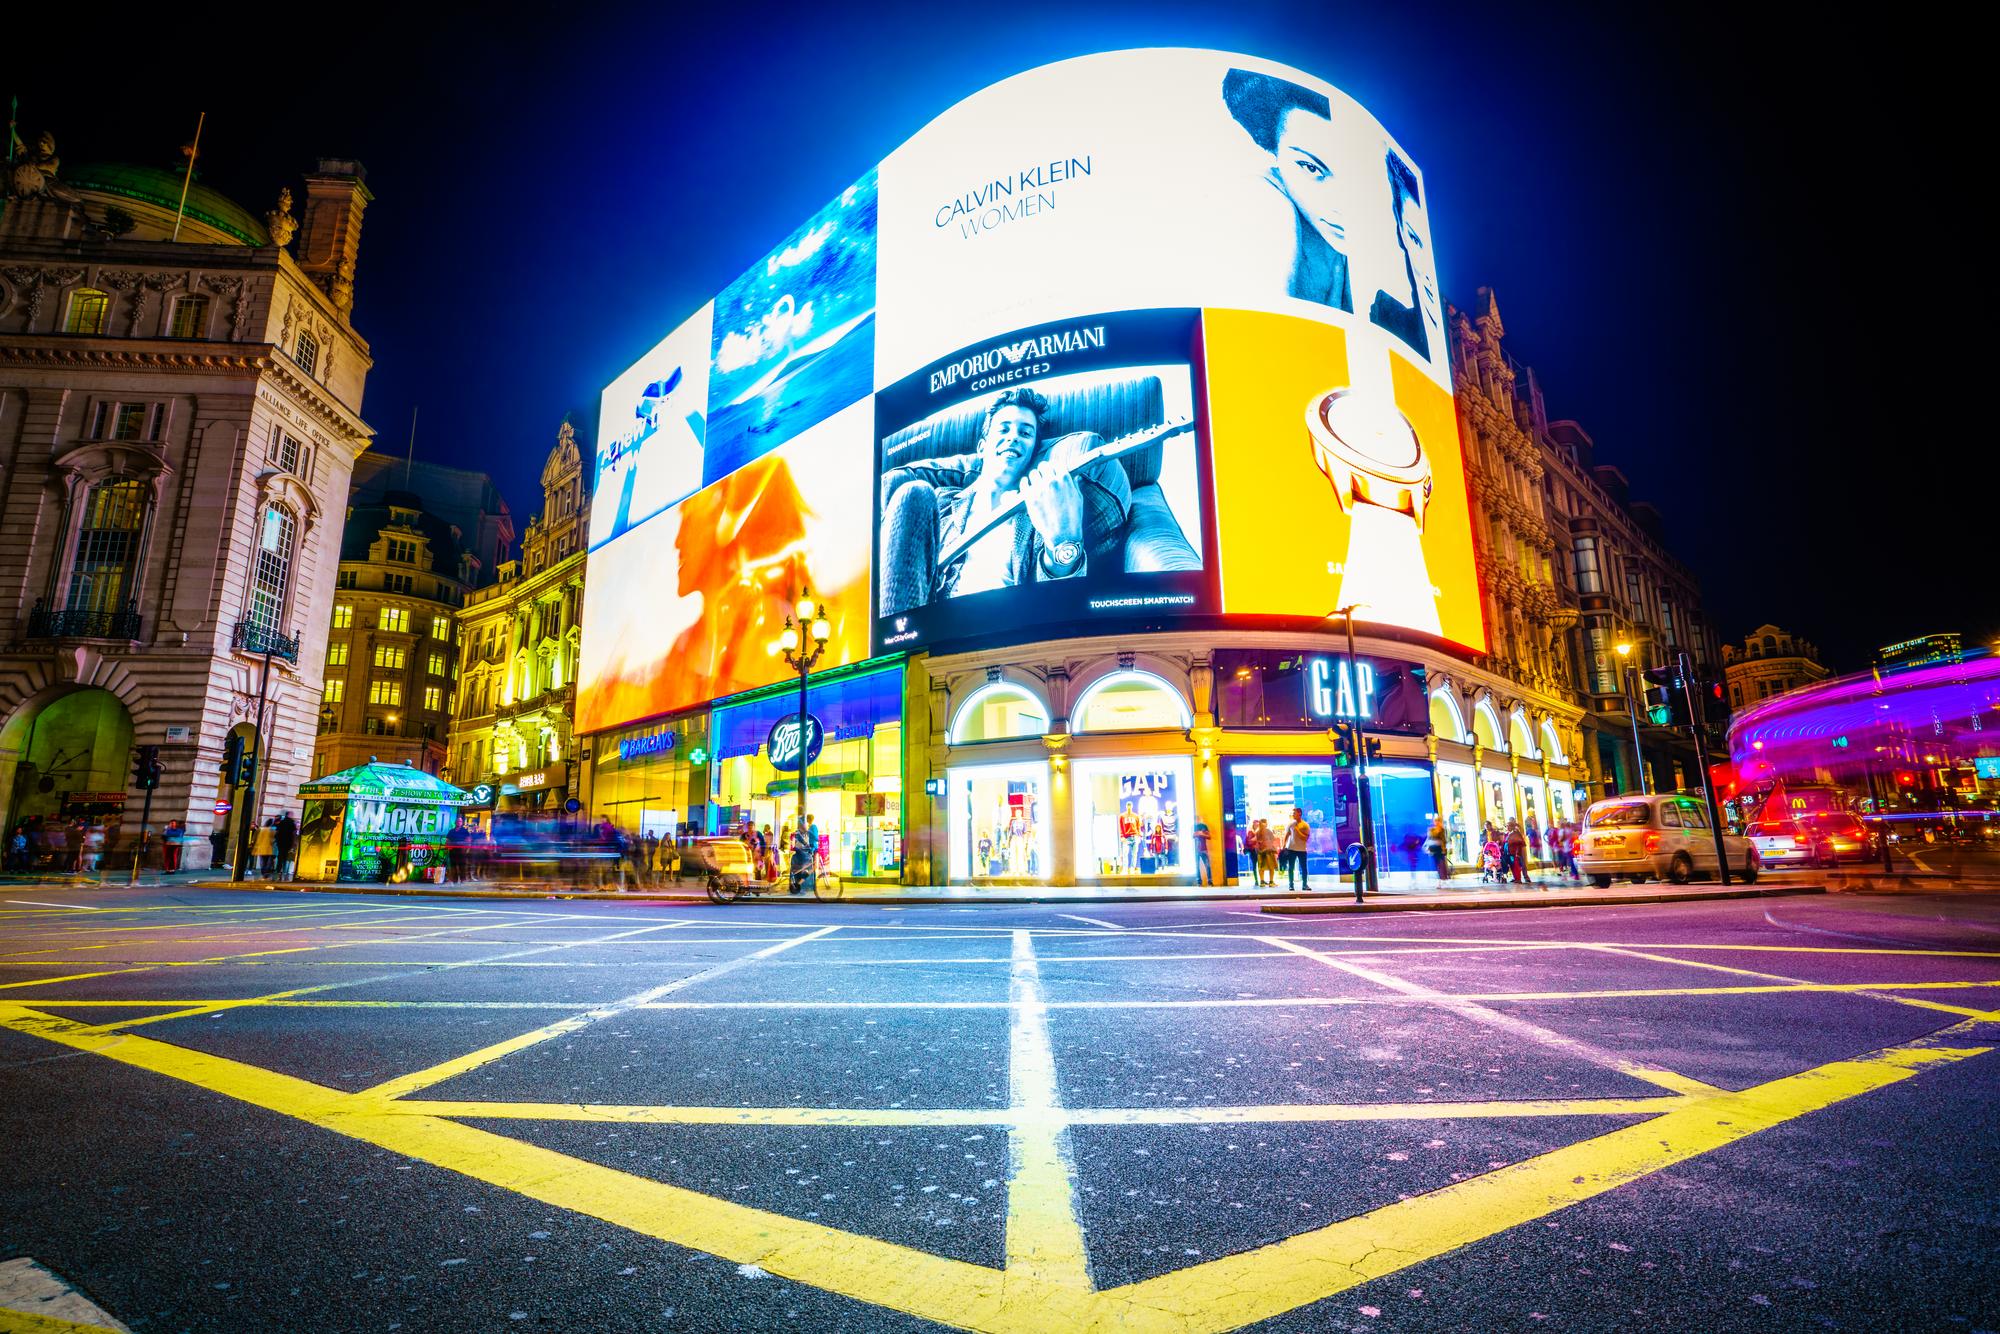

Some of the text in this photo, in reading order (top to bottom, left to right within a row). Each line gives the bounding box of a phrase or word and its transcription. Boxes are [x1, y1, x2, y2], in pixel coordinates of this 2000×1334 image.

[936, 155, 1091, 228] CALVIN KLEIN
[961, 190, 1055, 239] WOMEN
[930, 326, 1106, 394] EMPORIO ARMANI
[971, 363, 1050, 391] CONNECTED
[261, 390, 330, 448] ALLIANCE LIFE OFFICE
[1090, 596, 1194, 608] TOUCHSCREEN SMARTWATCH
[1312, 659, 1374, 718] GAP
[629, 731, 676, 756] BARCLAYS
[770, 720, 814, 763] Boos
[834, 720, 876, 740] beauty
[401, 788, 423, 797] SHOW
[1742, 796, 1754, 804] 38
[410, 848, 427, 858] 100
